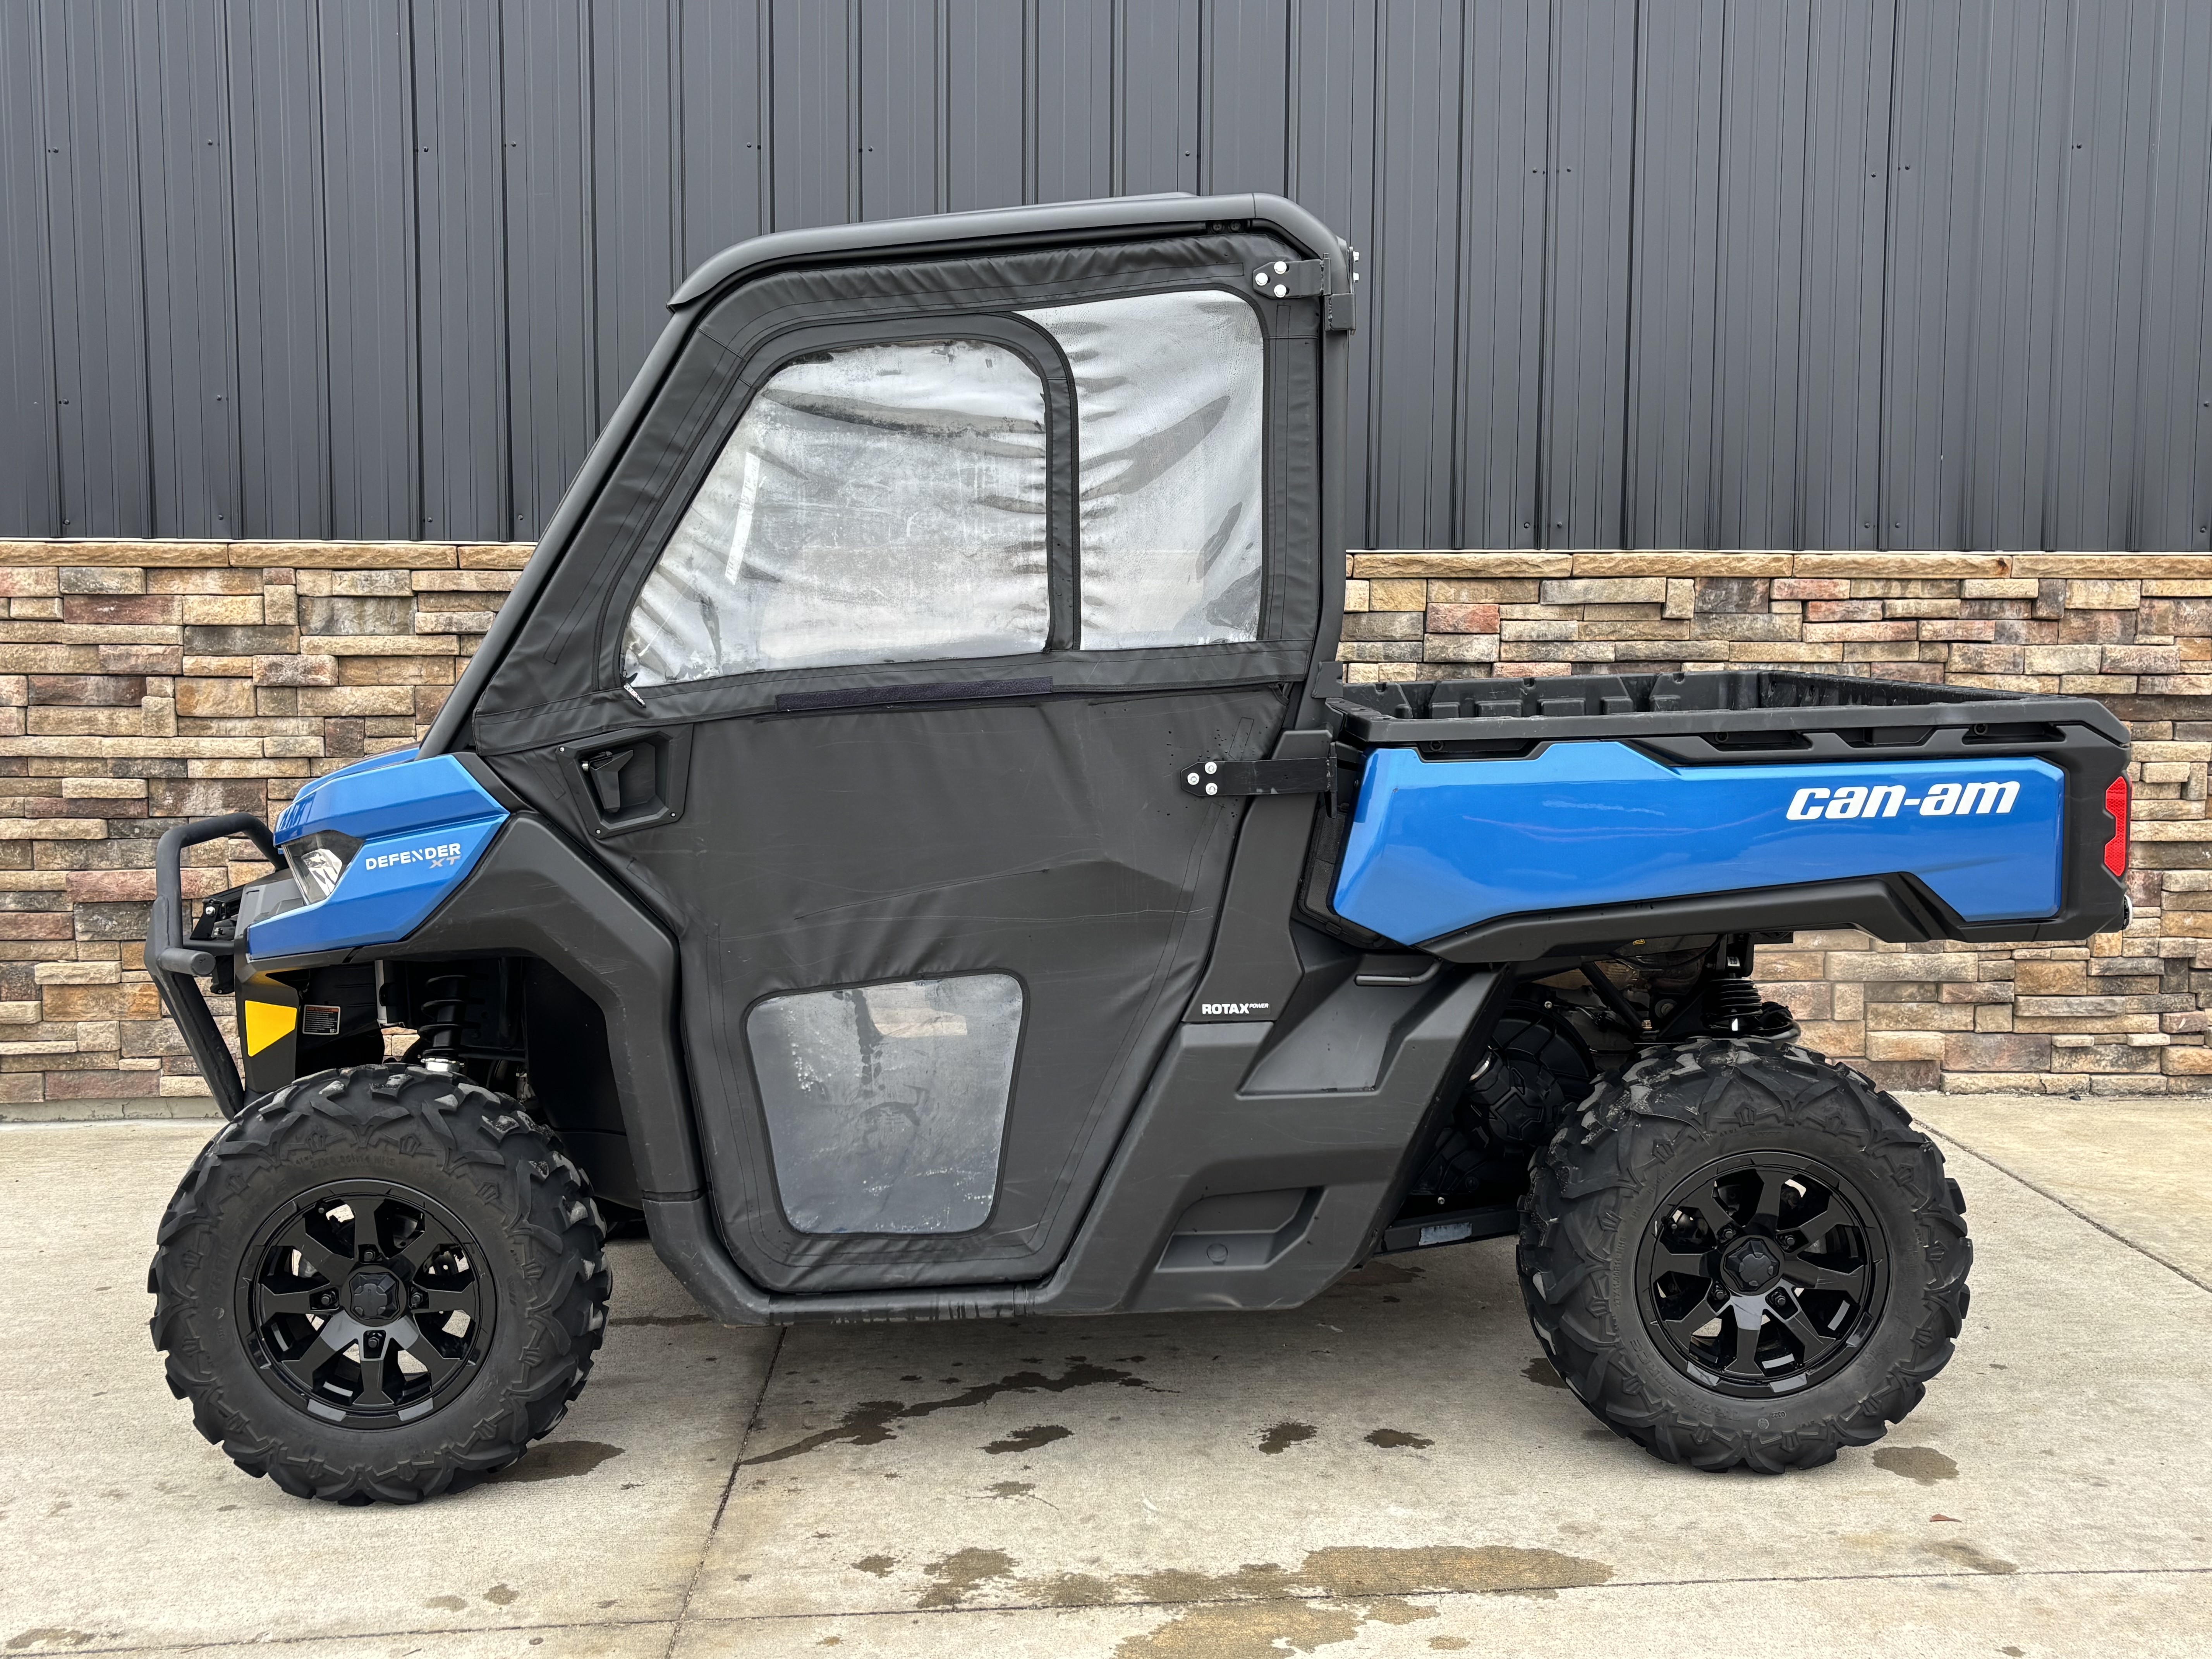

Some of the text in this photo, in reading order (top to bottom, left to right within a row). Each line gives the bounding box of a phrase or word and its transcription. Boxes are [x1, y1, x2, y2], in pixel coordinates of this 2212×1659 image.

[1786, 781, 2020, 821] can-am
[365, 843, 461, 871] DEFENDER
[429, 855, 461, 869] XT
[1202, 1003, 1250, 1015] ROTAX
